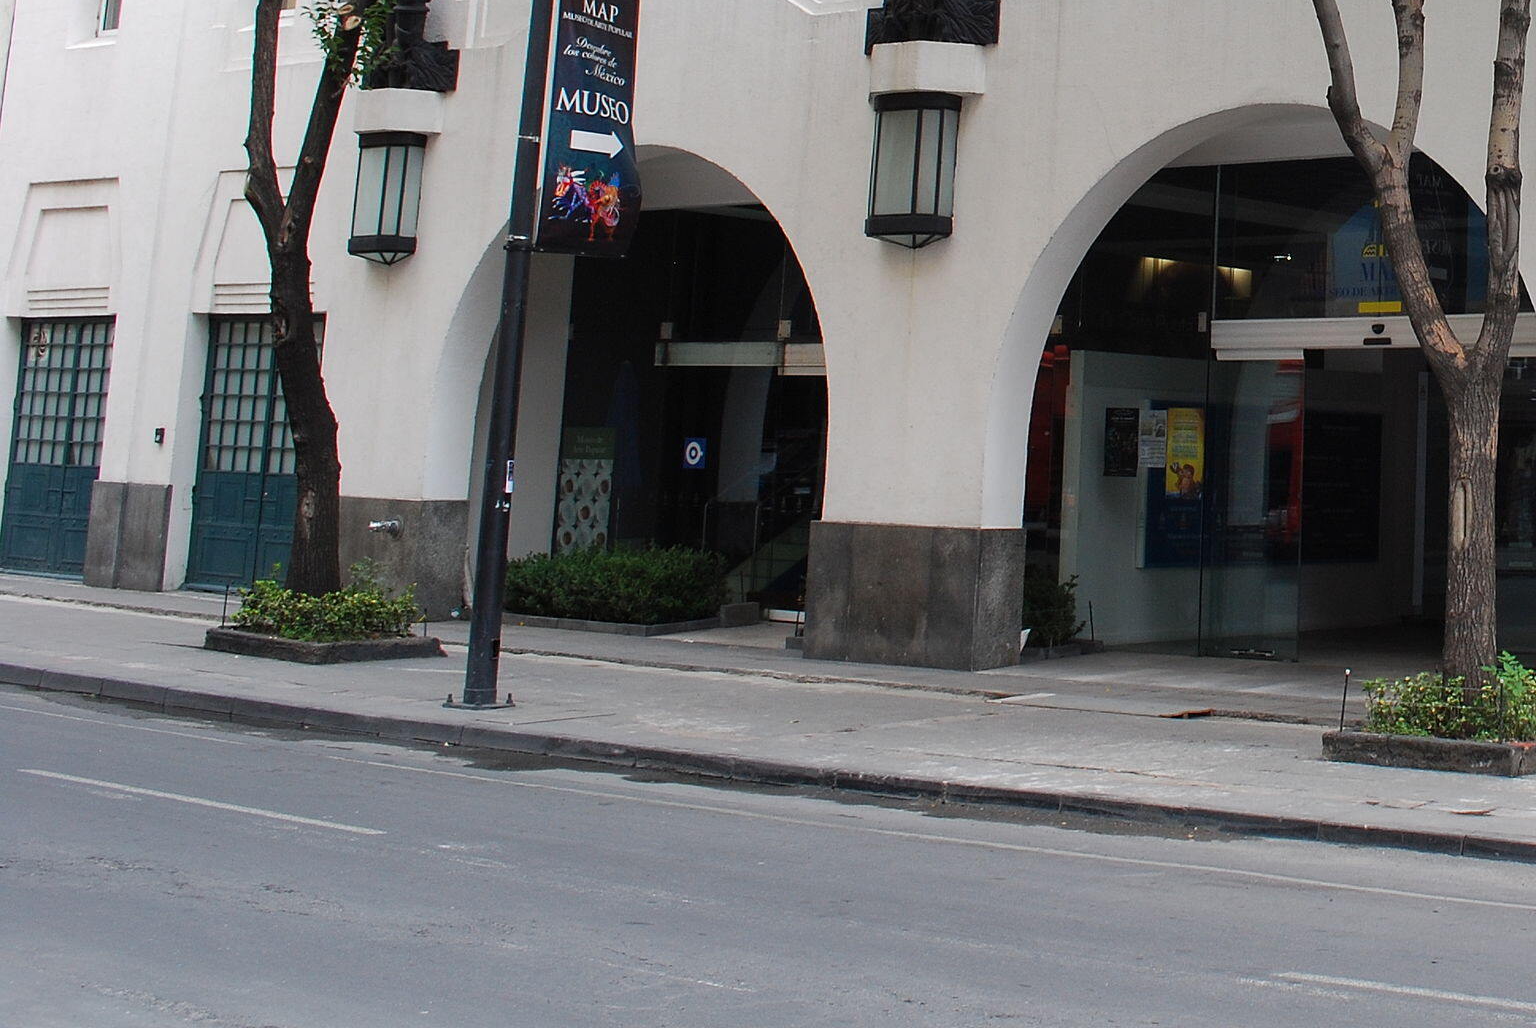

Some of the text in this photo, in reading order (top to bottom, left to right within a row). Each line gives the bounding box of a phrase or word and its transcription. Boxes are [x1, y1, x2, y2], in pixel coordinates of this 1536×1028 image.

[607, 57, 617, 69] de
[585, 64, 625, 87] México
[556, 87, 629, 125] MUSEO
